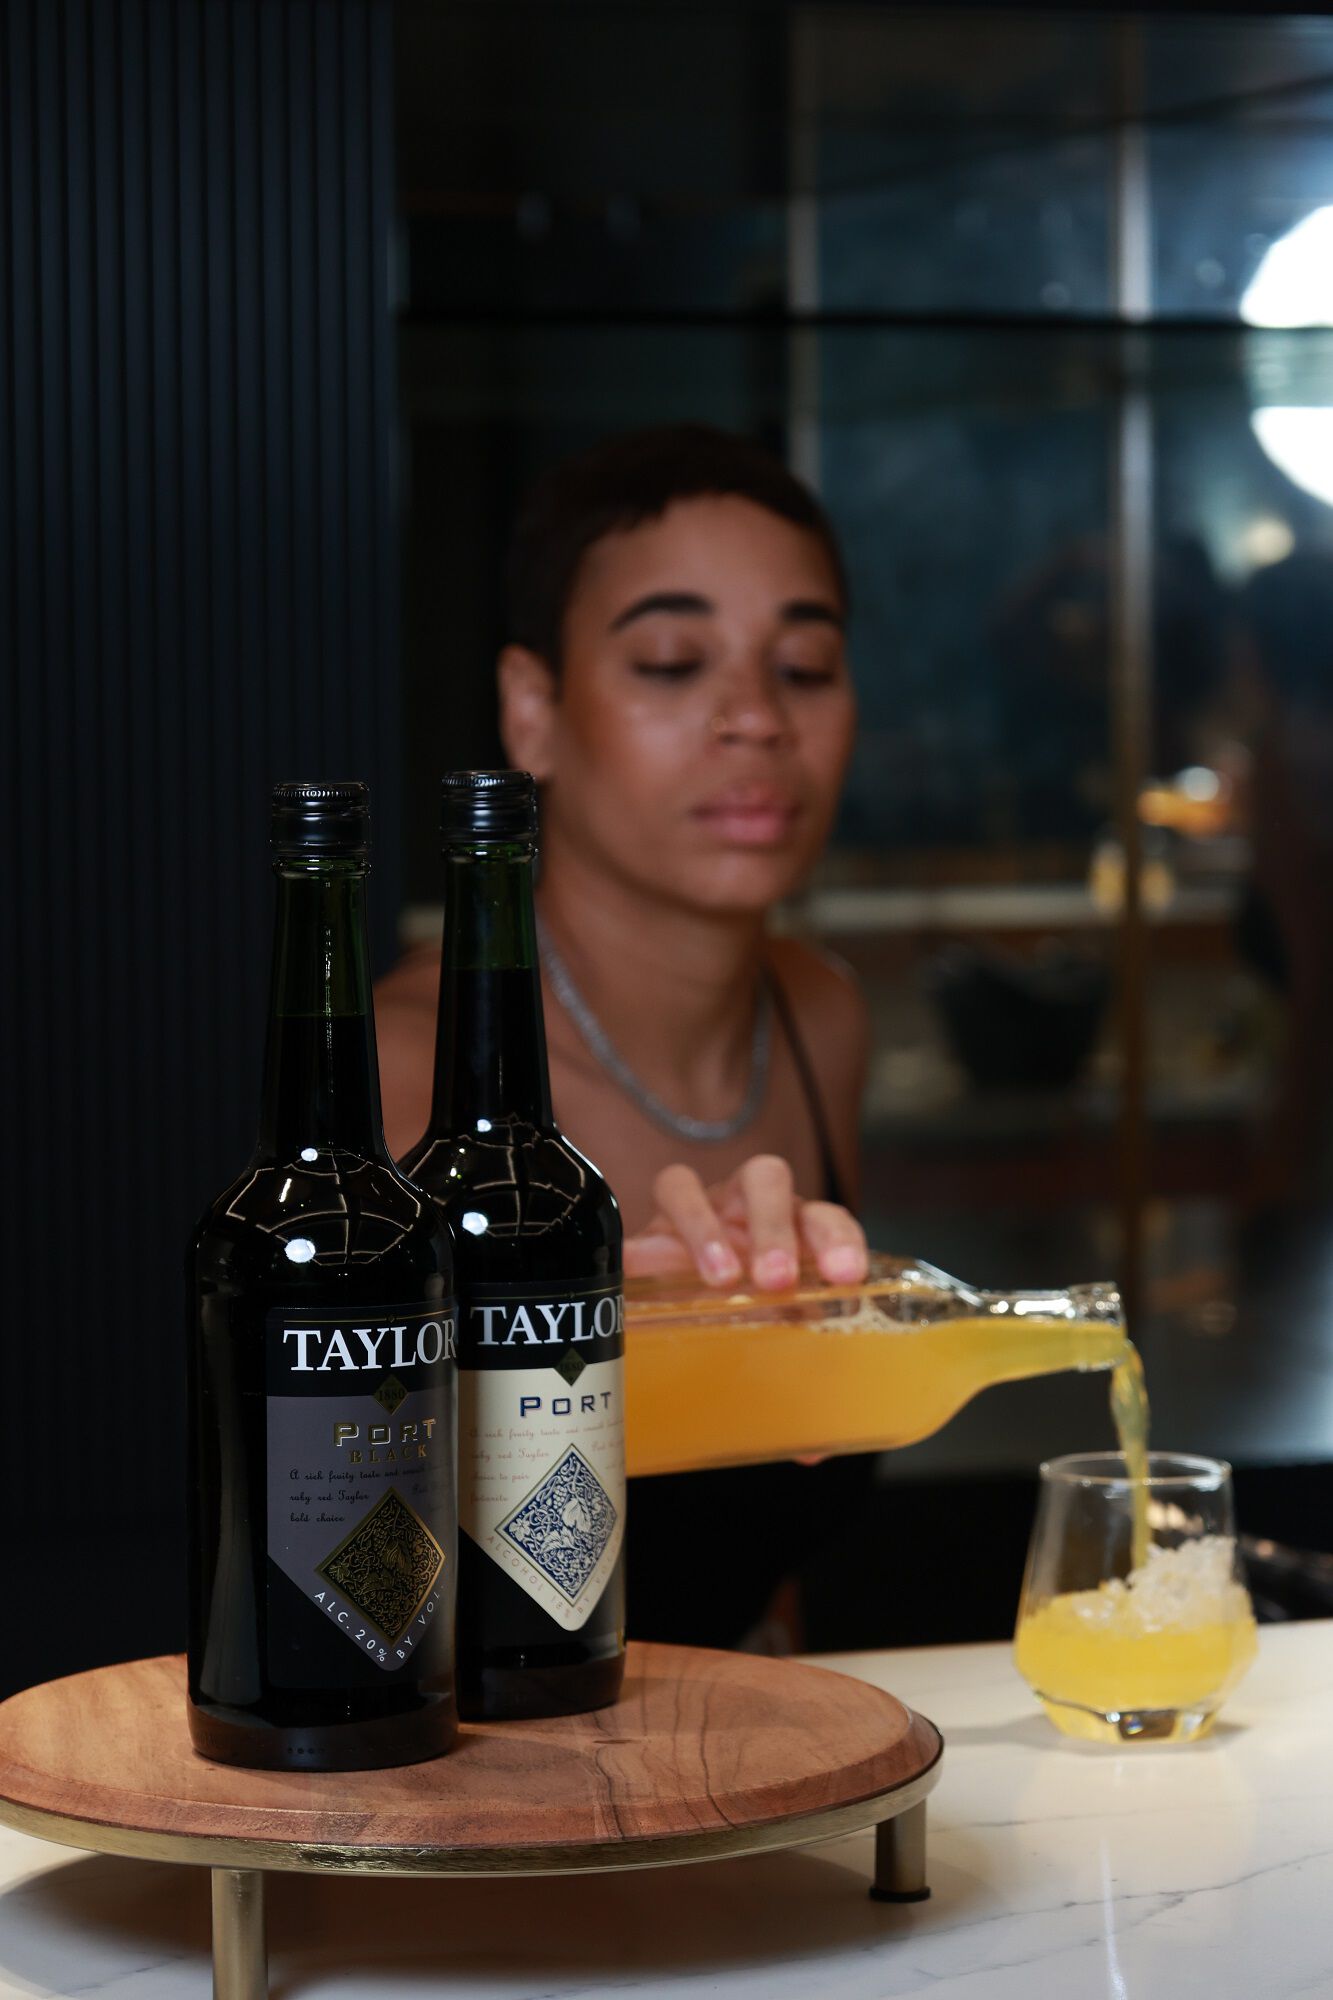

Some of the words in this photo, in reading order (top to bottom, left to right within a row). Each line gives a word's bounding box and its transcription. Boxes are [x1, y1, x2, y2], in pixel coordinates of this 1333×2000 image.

[283, 1319, 457, 1371] TAYLOR
[520, 1392, 611, 1418] PORT
[333, 1418, 437, 1447] PORT
[350, 1444, 428, 1465] BLACK
[289, 1469, 300, 1480] A
[304, 1470, 324, 1480] rich
[328, 1469, 355, 1483] fruity
[360, 1468, 382, 1479] taste
[289, 1490, 311, 1504] ruby
[317, 1491, 332, 1501] red
[338, 1490, 370, 1504] Taylor
[290, 1513, 310, 1522] bold
[316, 1513, 345, 1522] choice
[314, 1591, 350, 1629] ALC.
[355, 1629, 388, 1662] 20%
[396, 1636, 413, 1659] BY
